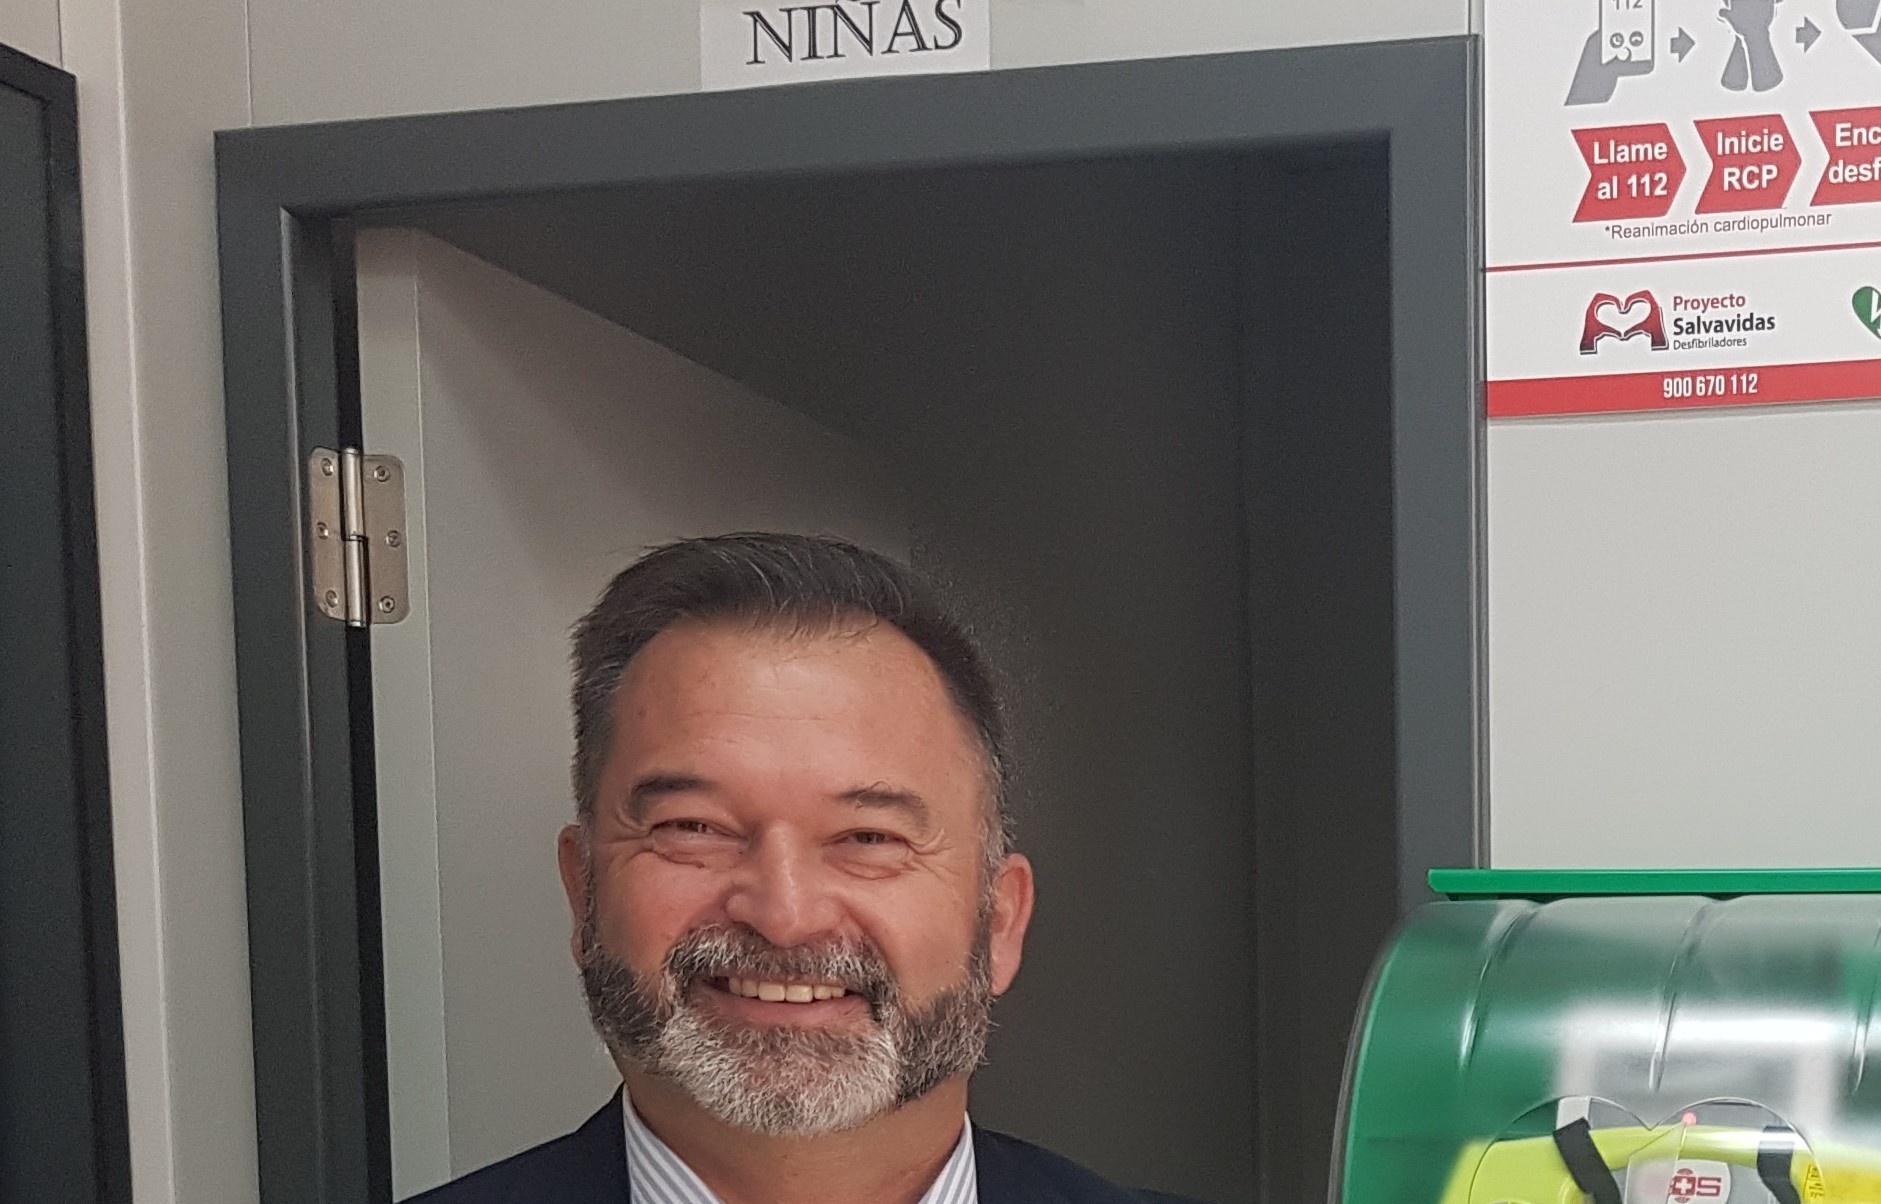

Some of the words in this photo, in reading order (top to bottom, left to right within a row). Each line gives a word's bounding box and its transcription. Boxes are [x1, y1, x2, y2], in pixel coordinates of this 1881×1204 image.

[1593, 140, 1668, 165] Llame
[1716, 129, 1784, 155] Inicie
[1597, 177, 1618, 200] al
[1627, 173, 1668, 197] 112
[1723, 164, 1778, 191] RCP
[1713, 213, 1832, 234] cardiopulmonar
[1673, 293, 1746, 315] Proyecto
[1673, 312, 1776, 336] Salvavidas
[1673, 337, 1747, 351] Desfibriladores
[1663, 378, 1692, 399] 900
[1696, 375, 1725, 396] 670
[1730, 373, 1758, 394] 112
